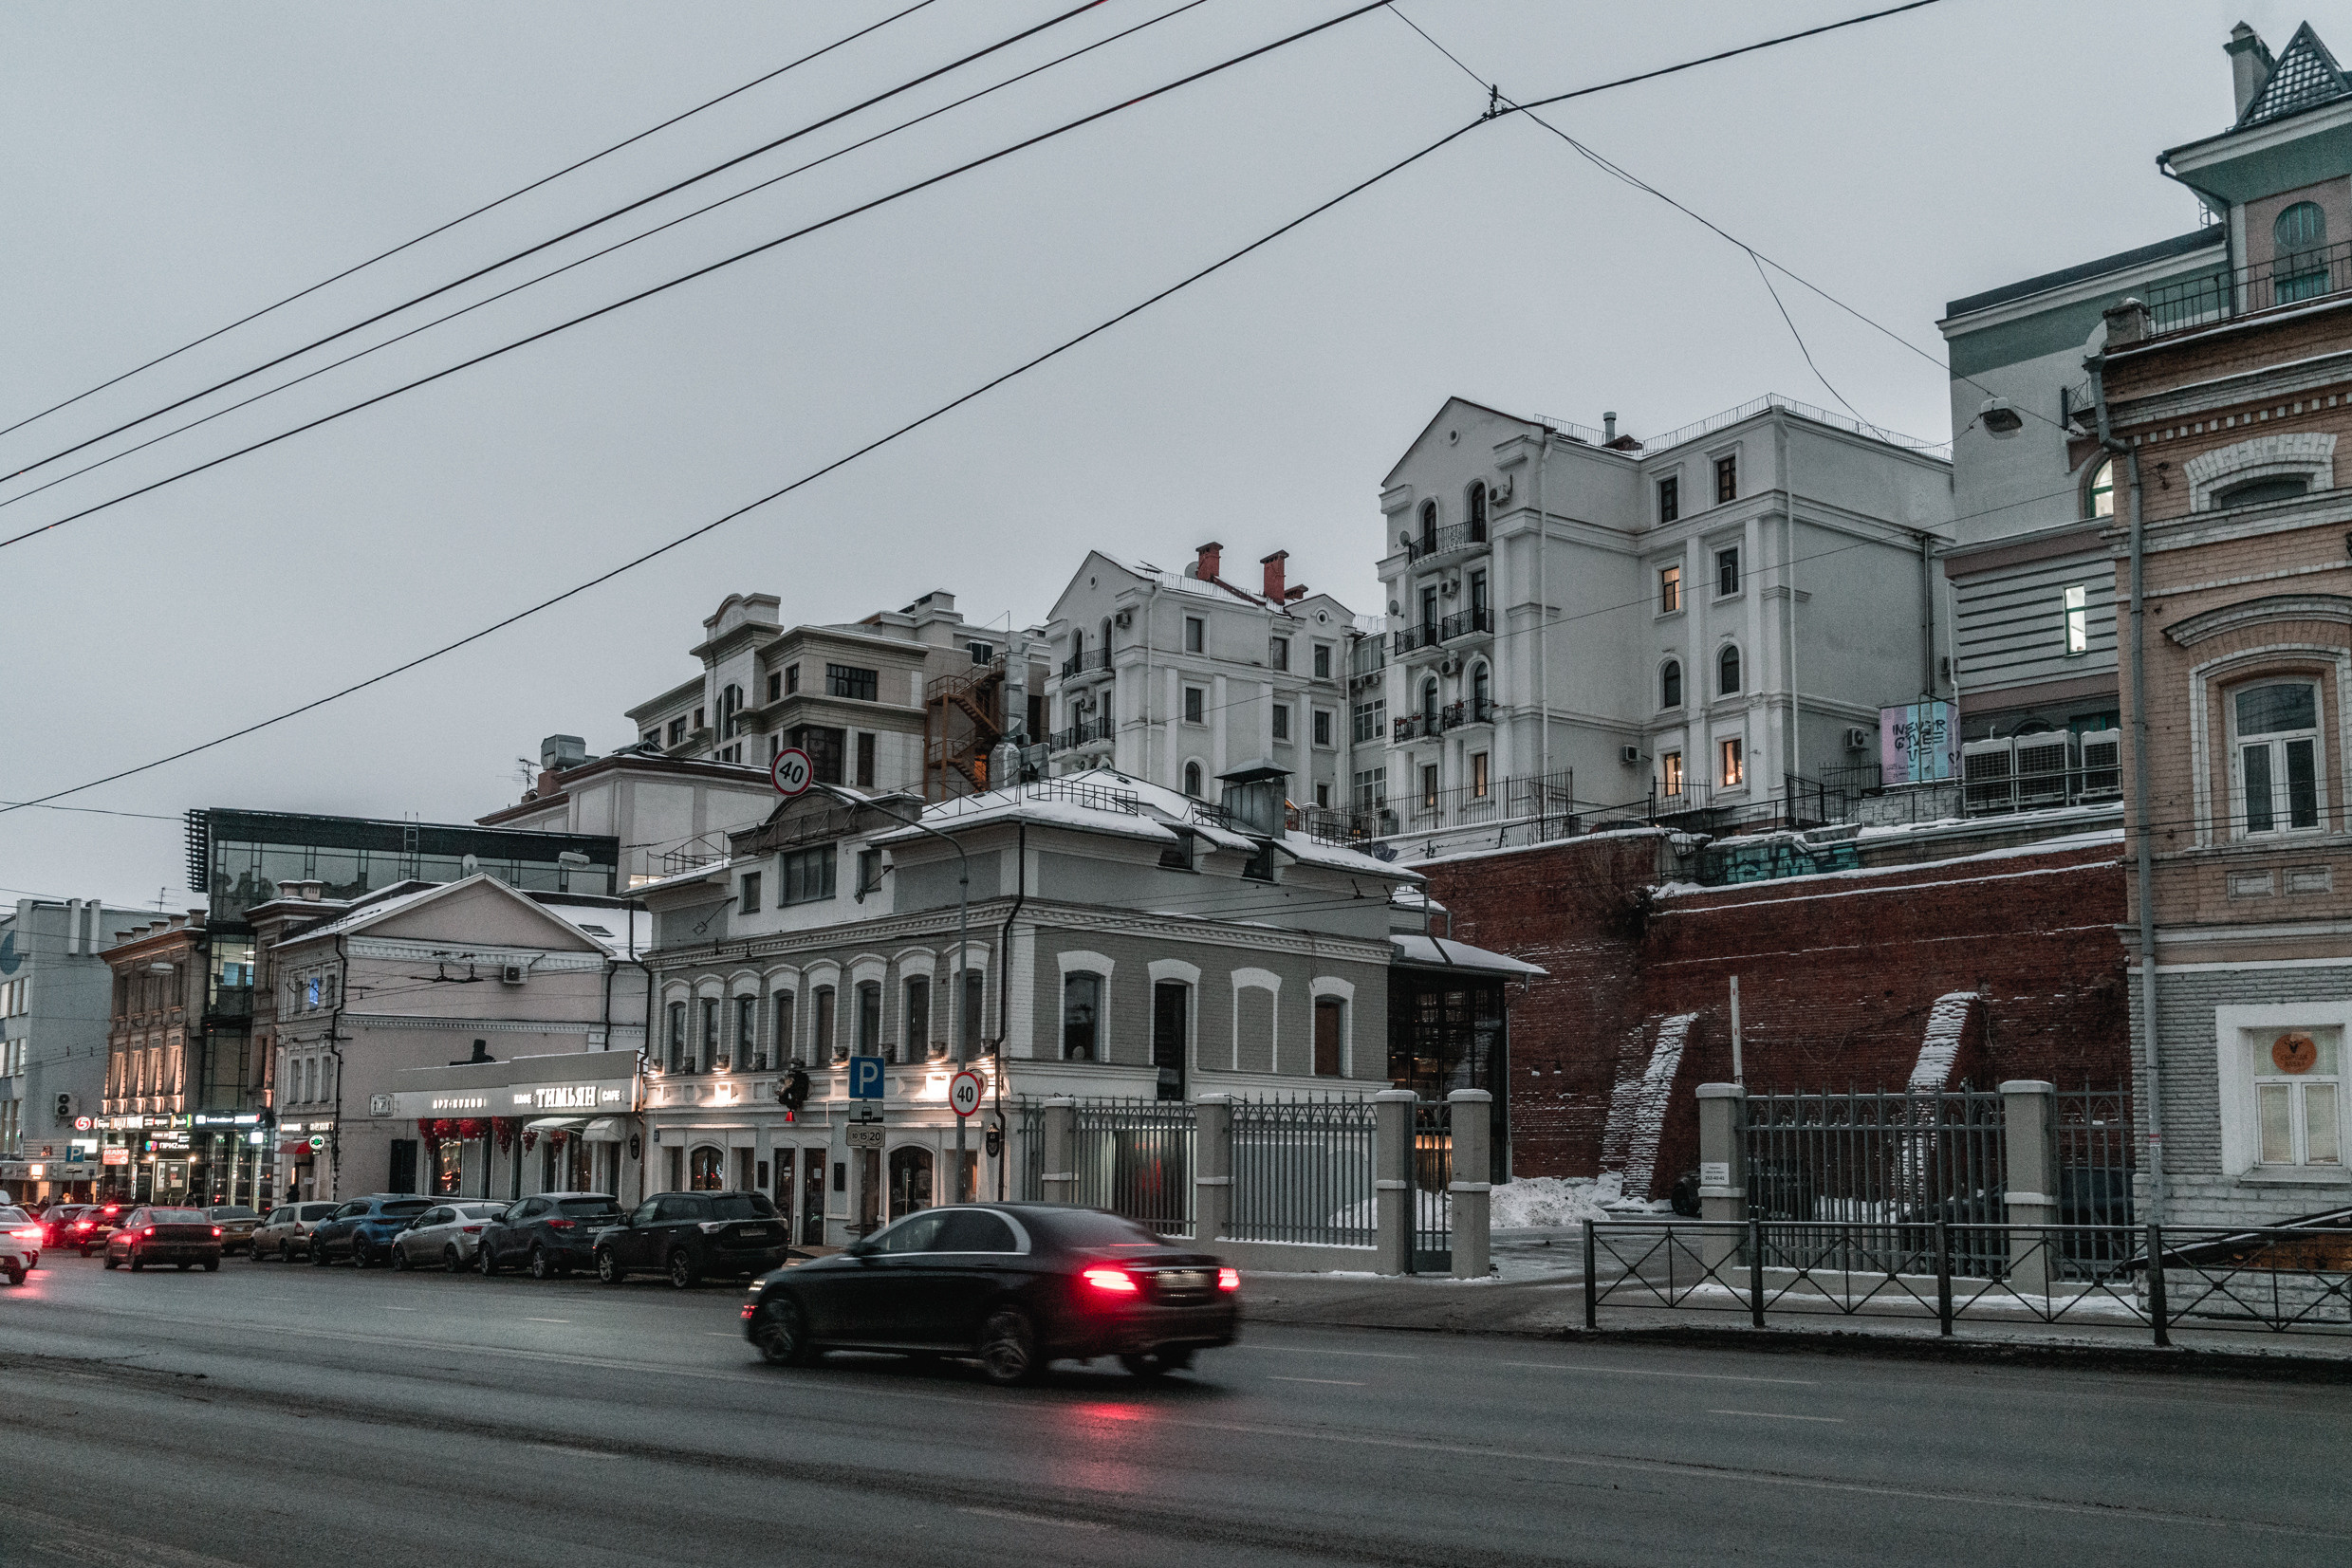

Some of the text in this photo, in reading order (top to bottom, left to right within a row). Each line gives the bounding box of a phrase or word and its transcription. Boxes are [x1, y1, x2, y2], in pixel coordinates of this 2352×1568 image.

[779, 761, 804, 784] 40
[859, 1061, 879, 1095] P
[536, 1086, 596, 1108] ТИМЬЯН
[956, 1085, 973, 1103] 40
[860, 1132, 867, 1140] 15
[869, 1132, 880, 1141] 20
[70, 1147, 82, 1160] P
